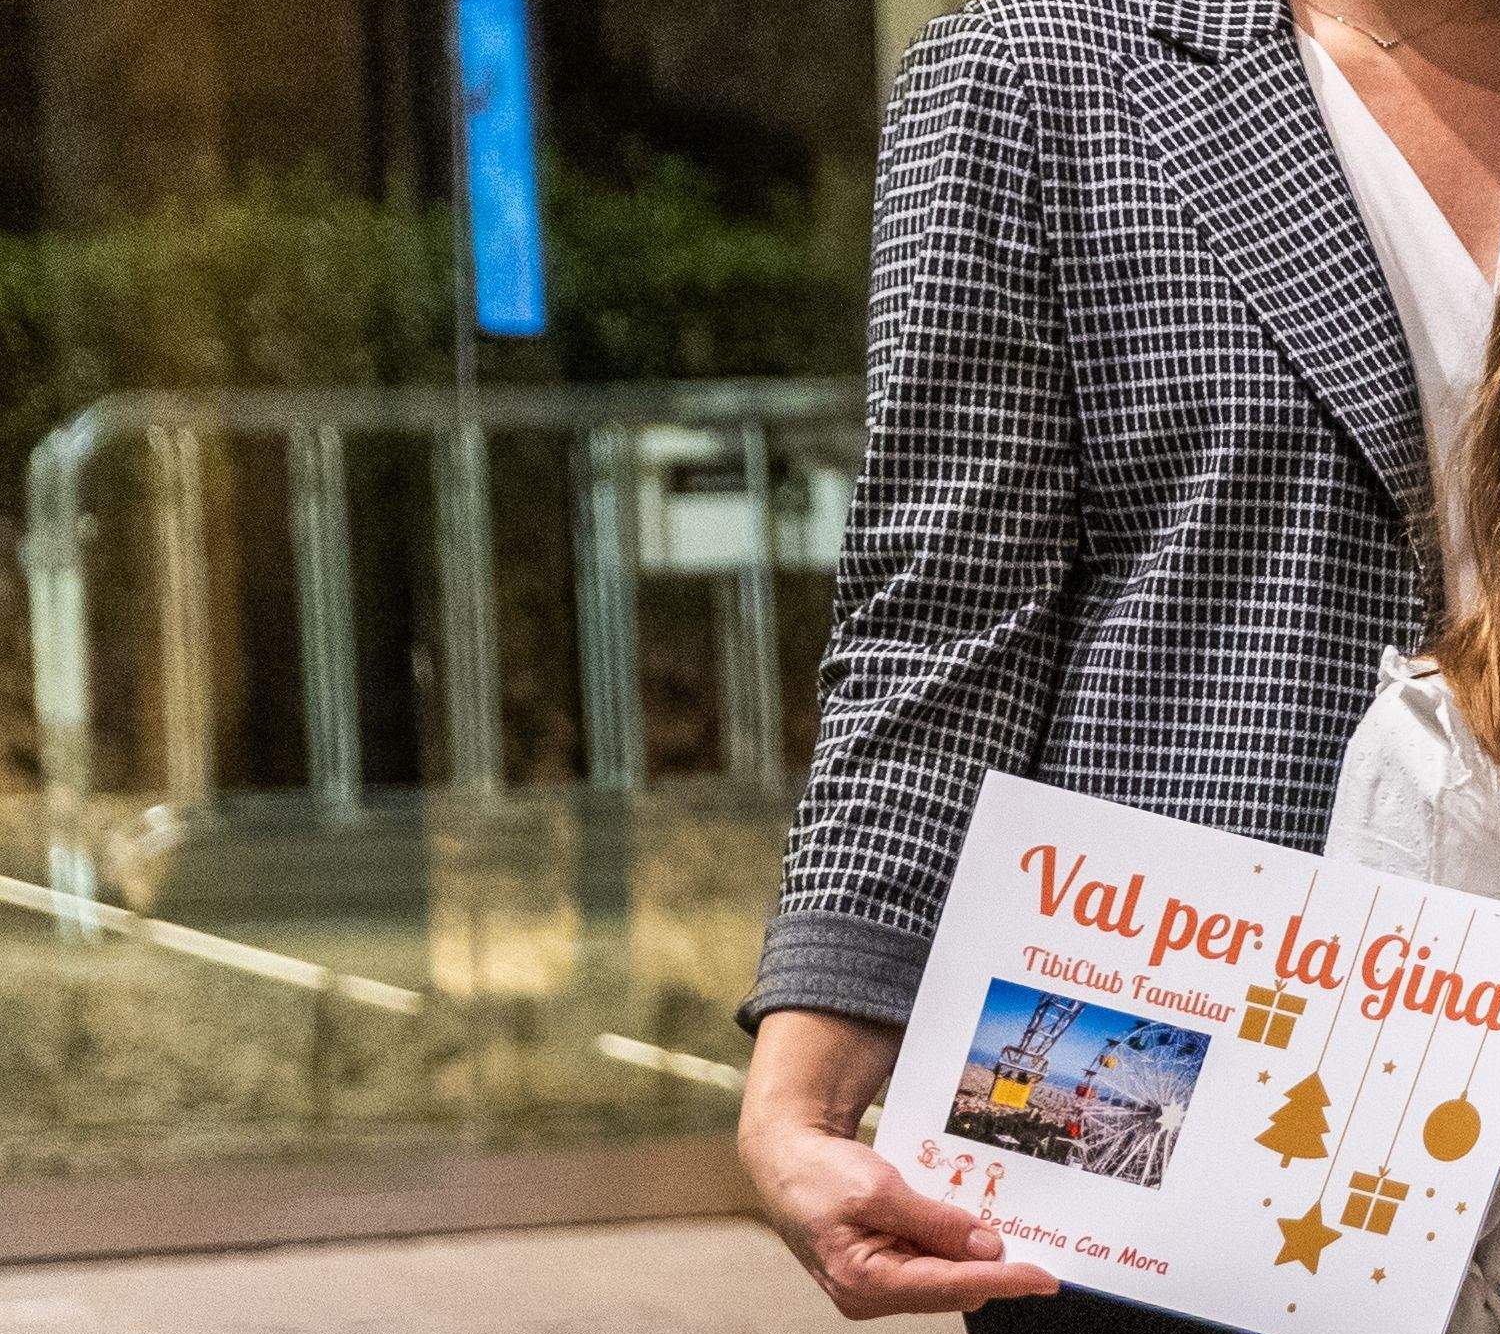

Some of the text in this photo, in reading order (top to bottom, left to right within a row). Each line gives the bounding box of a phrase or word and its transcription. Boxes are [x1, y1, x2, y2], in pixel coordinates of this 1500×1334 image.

[1020, 845, 1146, 940] Val
[1150, 897, 1264, 967] per
[1275, 916, 1344, 991] la
[1022, 945, 1236, 1025] TibiClub Familiar
[1075, 1236, 1168, 1275] Can Mora
